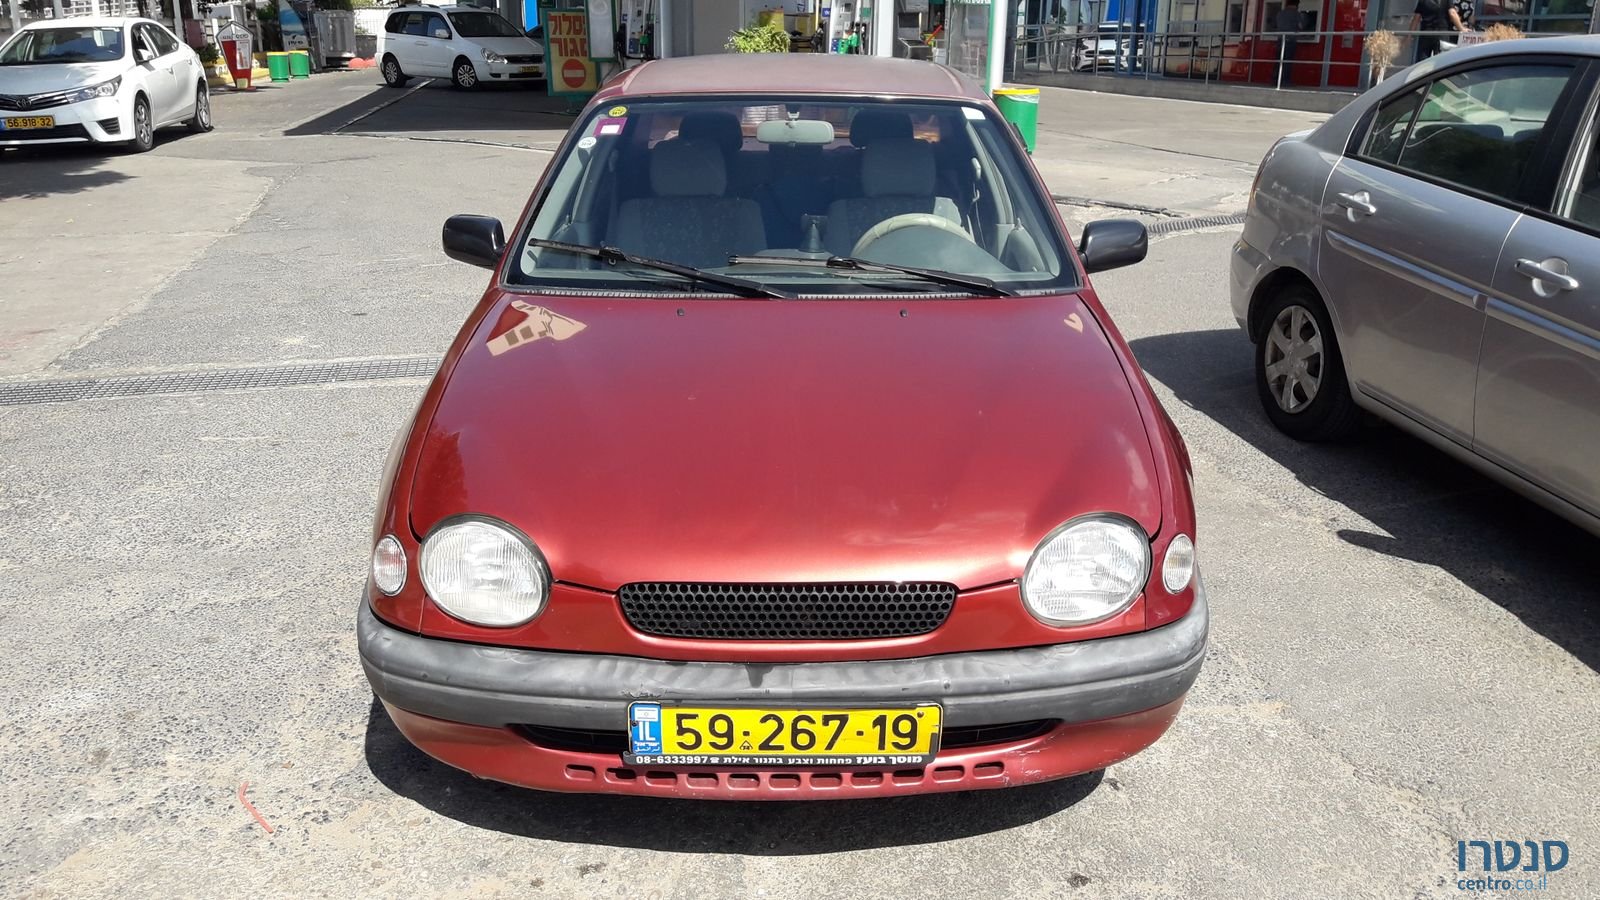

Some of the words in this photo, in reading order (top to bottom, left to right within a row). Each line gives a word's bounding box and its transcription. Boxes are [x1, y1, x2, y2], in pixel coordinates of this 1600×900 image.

[638, 721, 656, 741] IL
[636, 756, 708, 764] 08-6333997
[723, 756, 750, 764] אילת
[787, 757, 814, 765] וצבע
[856, 756, 886, 765] בועז
[889, 756, 923, 765] מוסך
